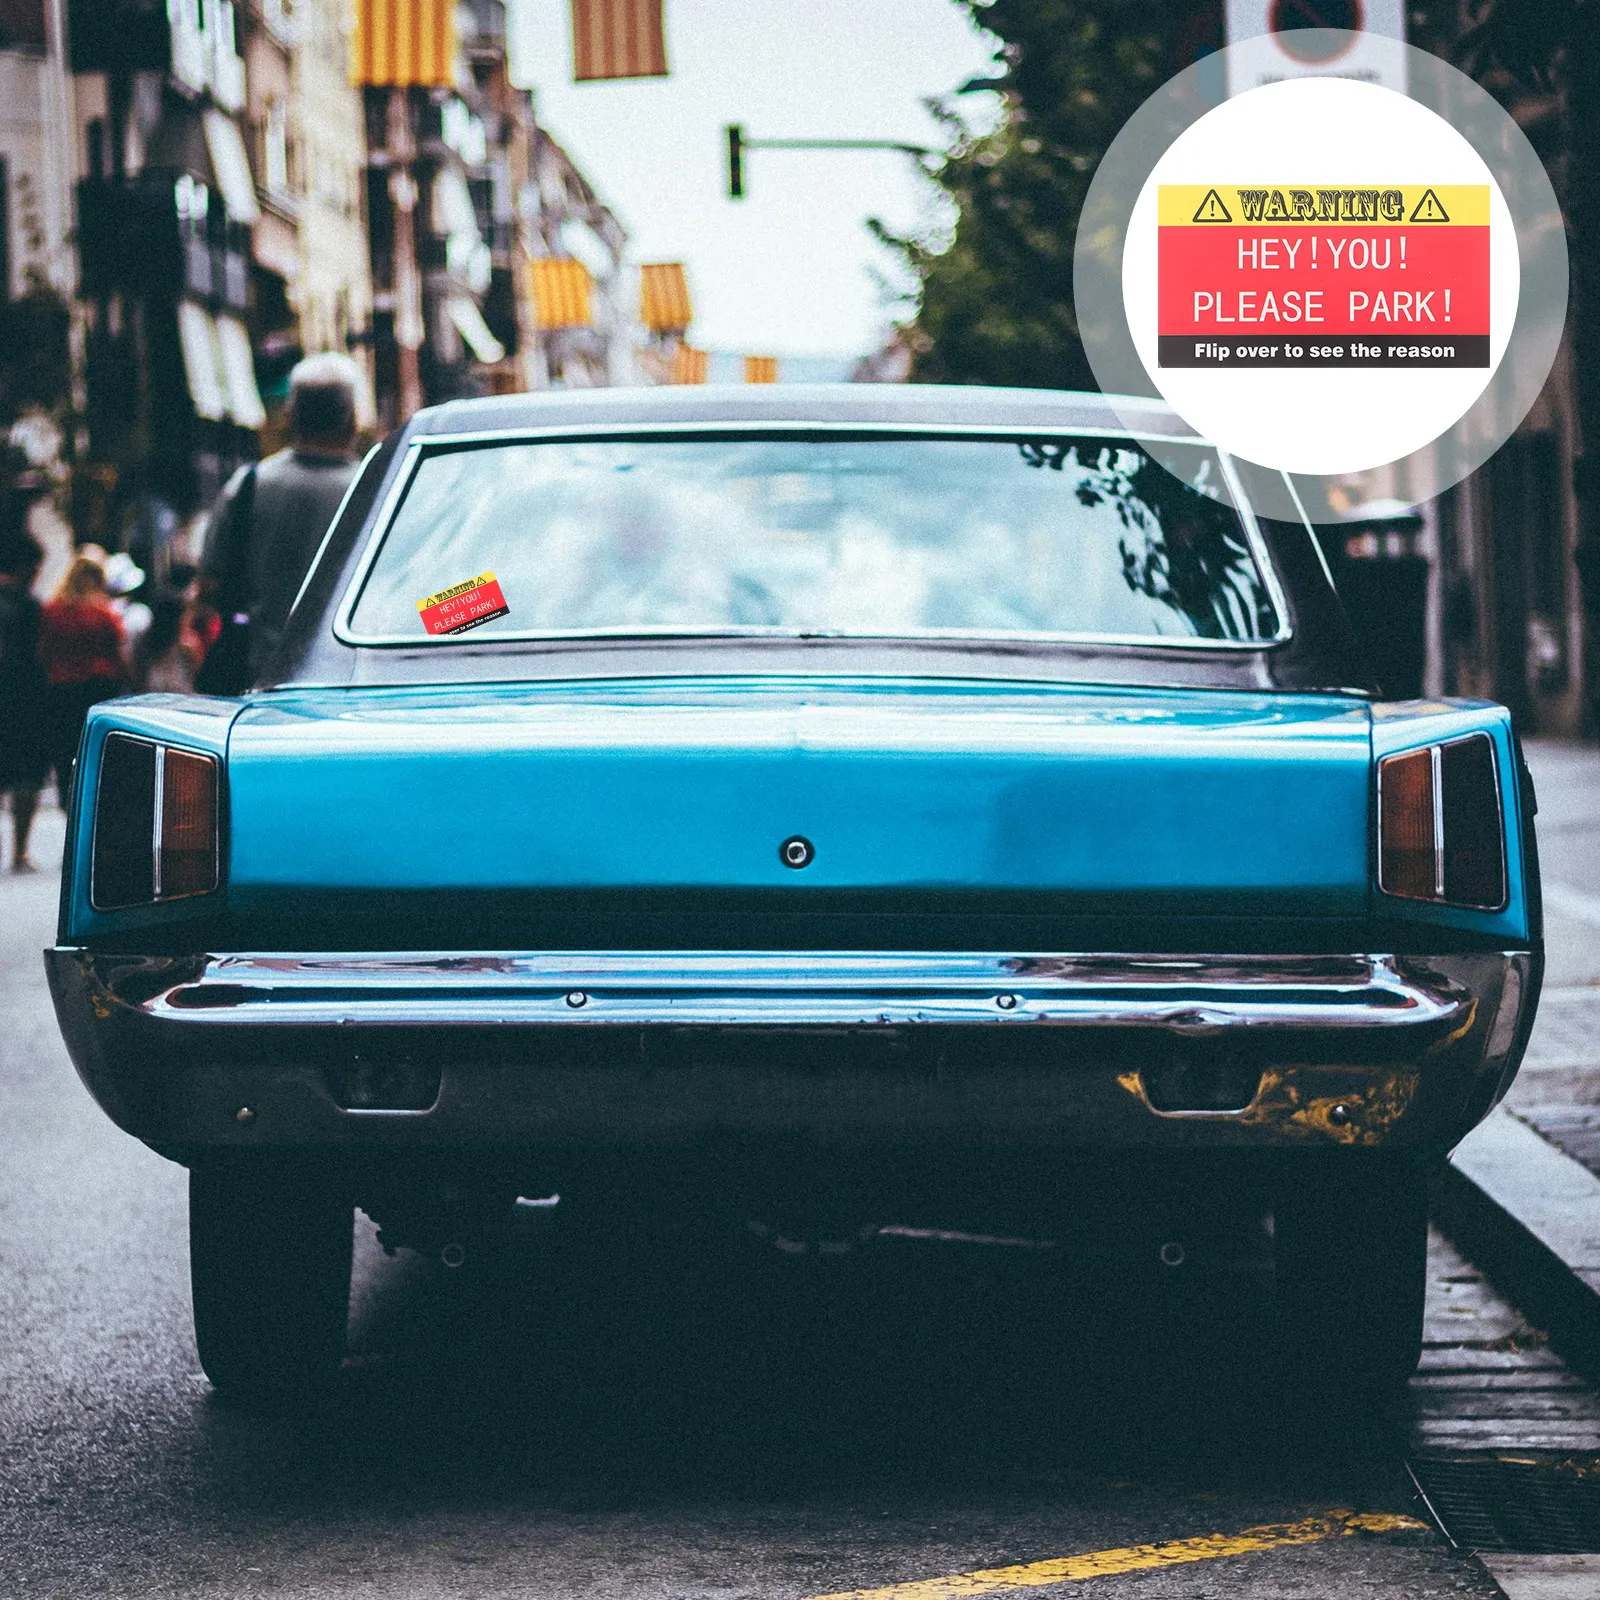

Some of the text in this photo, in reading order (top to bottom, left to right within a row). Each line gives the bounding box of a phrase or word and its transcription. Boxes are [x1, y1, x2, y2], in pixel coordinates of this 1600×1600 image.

[435, 580, 476, 602] WARNING
[433, 598, 497, 631] PLEASE PARK!
